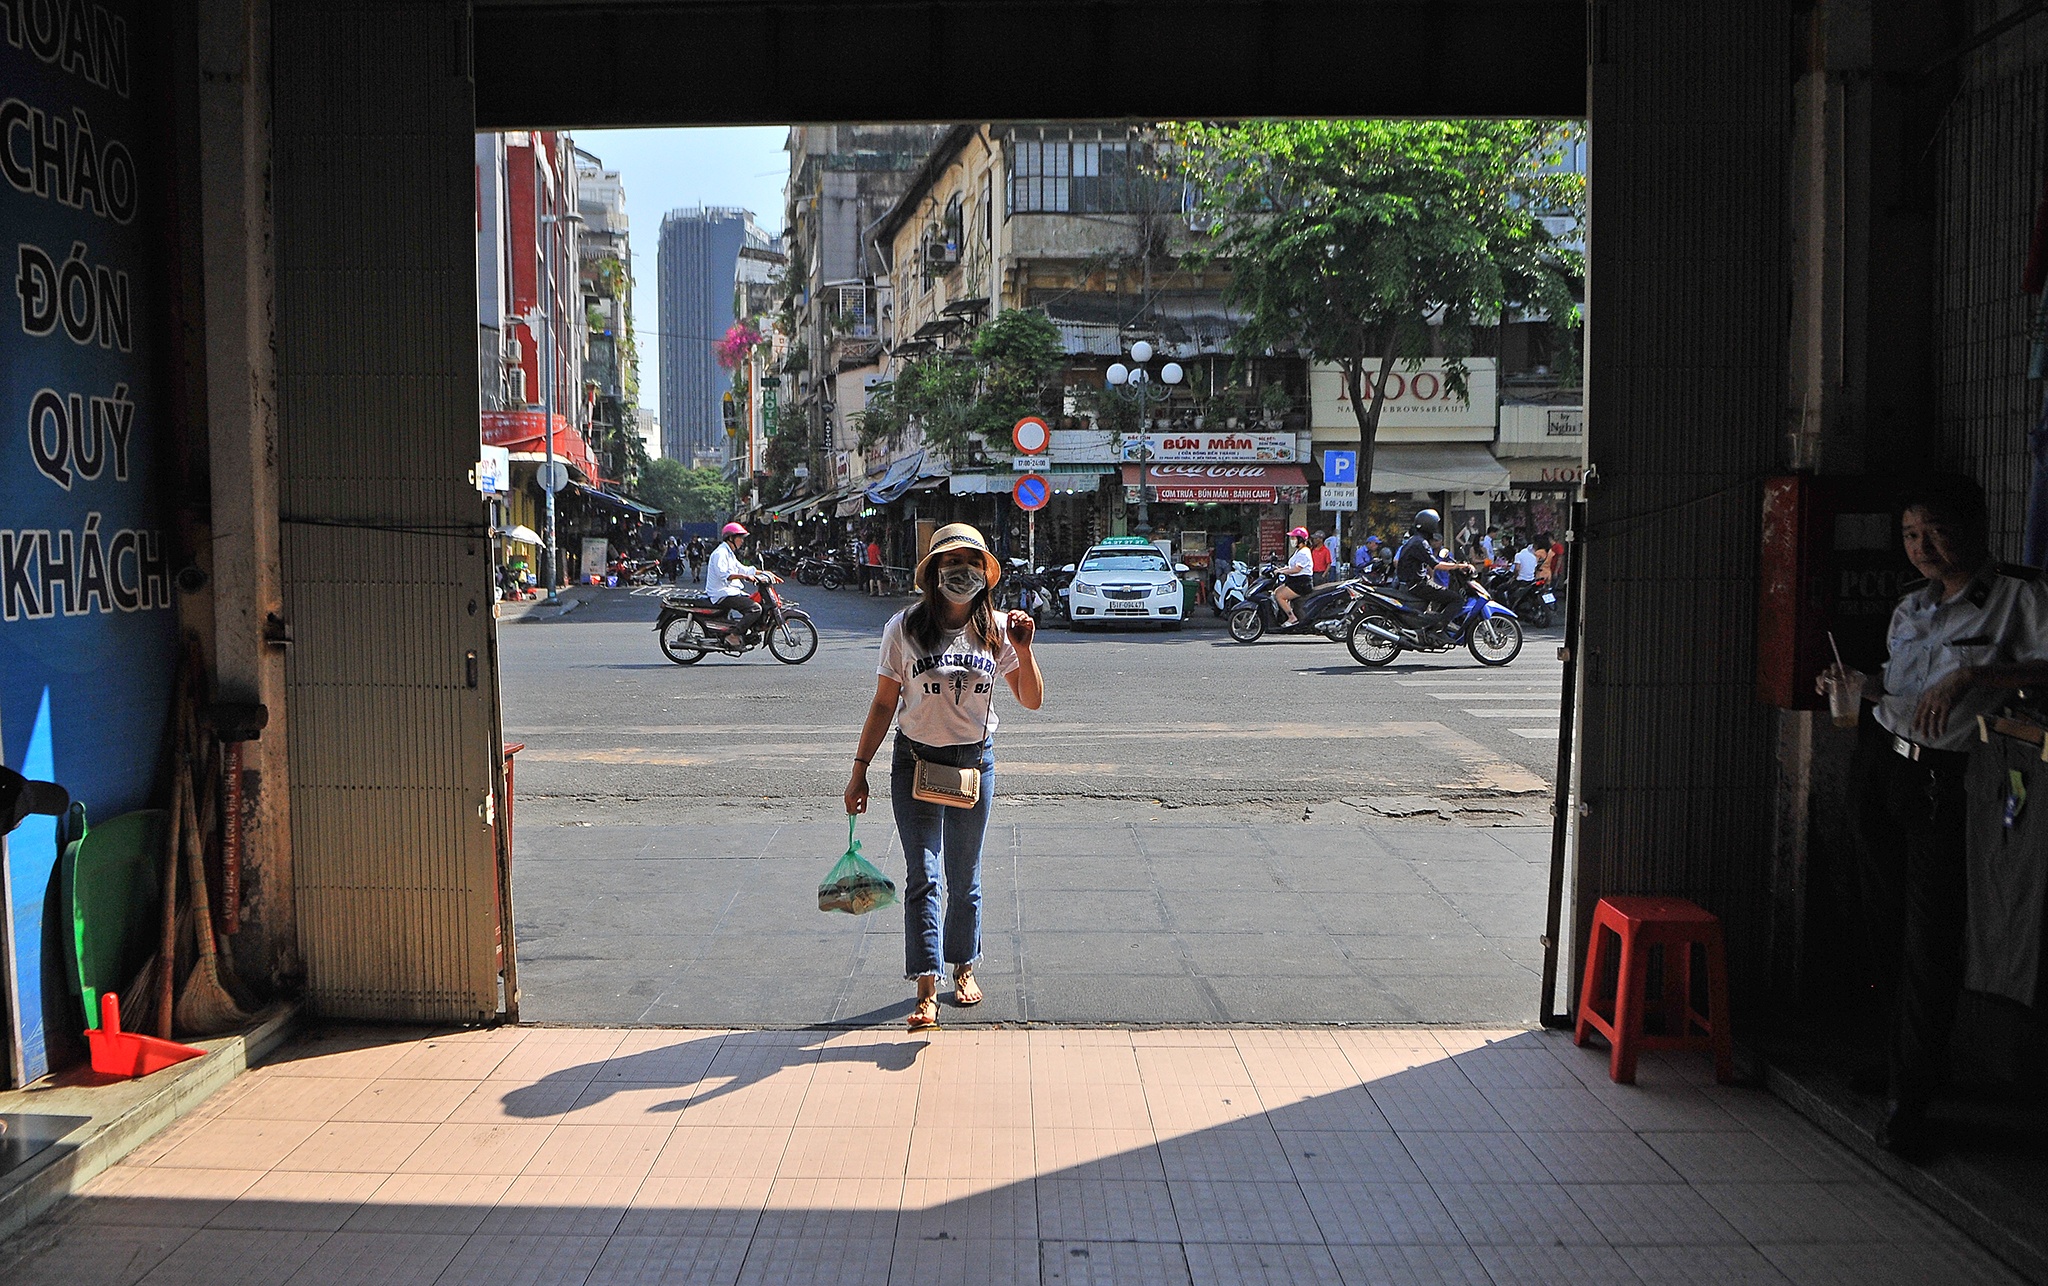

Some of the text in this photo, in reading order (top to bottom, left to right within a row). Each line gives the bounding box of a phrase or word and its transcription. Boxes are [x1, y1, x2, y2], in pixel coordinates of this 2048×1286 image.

[0, 98, 137, 224] CHÀO
[17, 242, 132, 352] ĐÓN
[765, 392, 775, 436] HOTEL
[28, 383, 135, 490] QUÝ
[1163, 433, 1252, 449] BÚN MẮM
[1335, 457, 1350, 476] P
[1198, 488, 1212, 498] BÚN
[1233, 487, 1251, 498] BÁNH
[1252, 489, 1270, 498] CANH
[1324, 489, 1332, 497] CÓ
[1345, 489, 1355, 497] PHÍ
[1, 512, 171, 620] KHÁCH
[923, 682, 941, 694] 18
